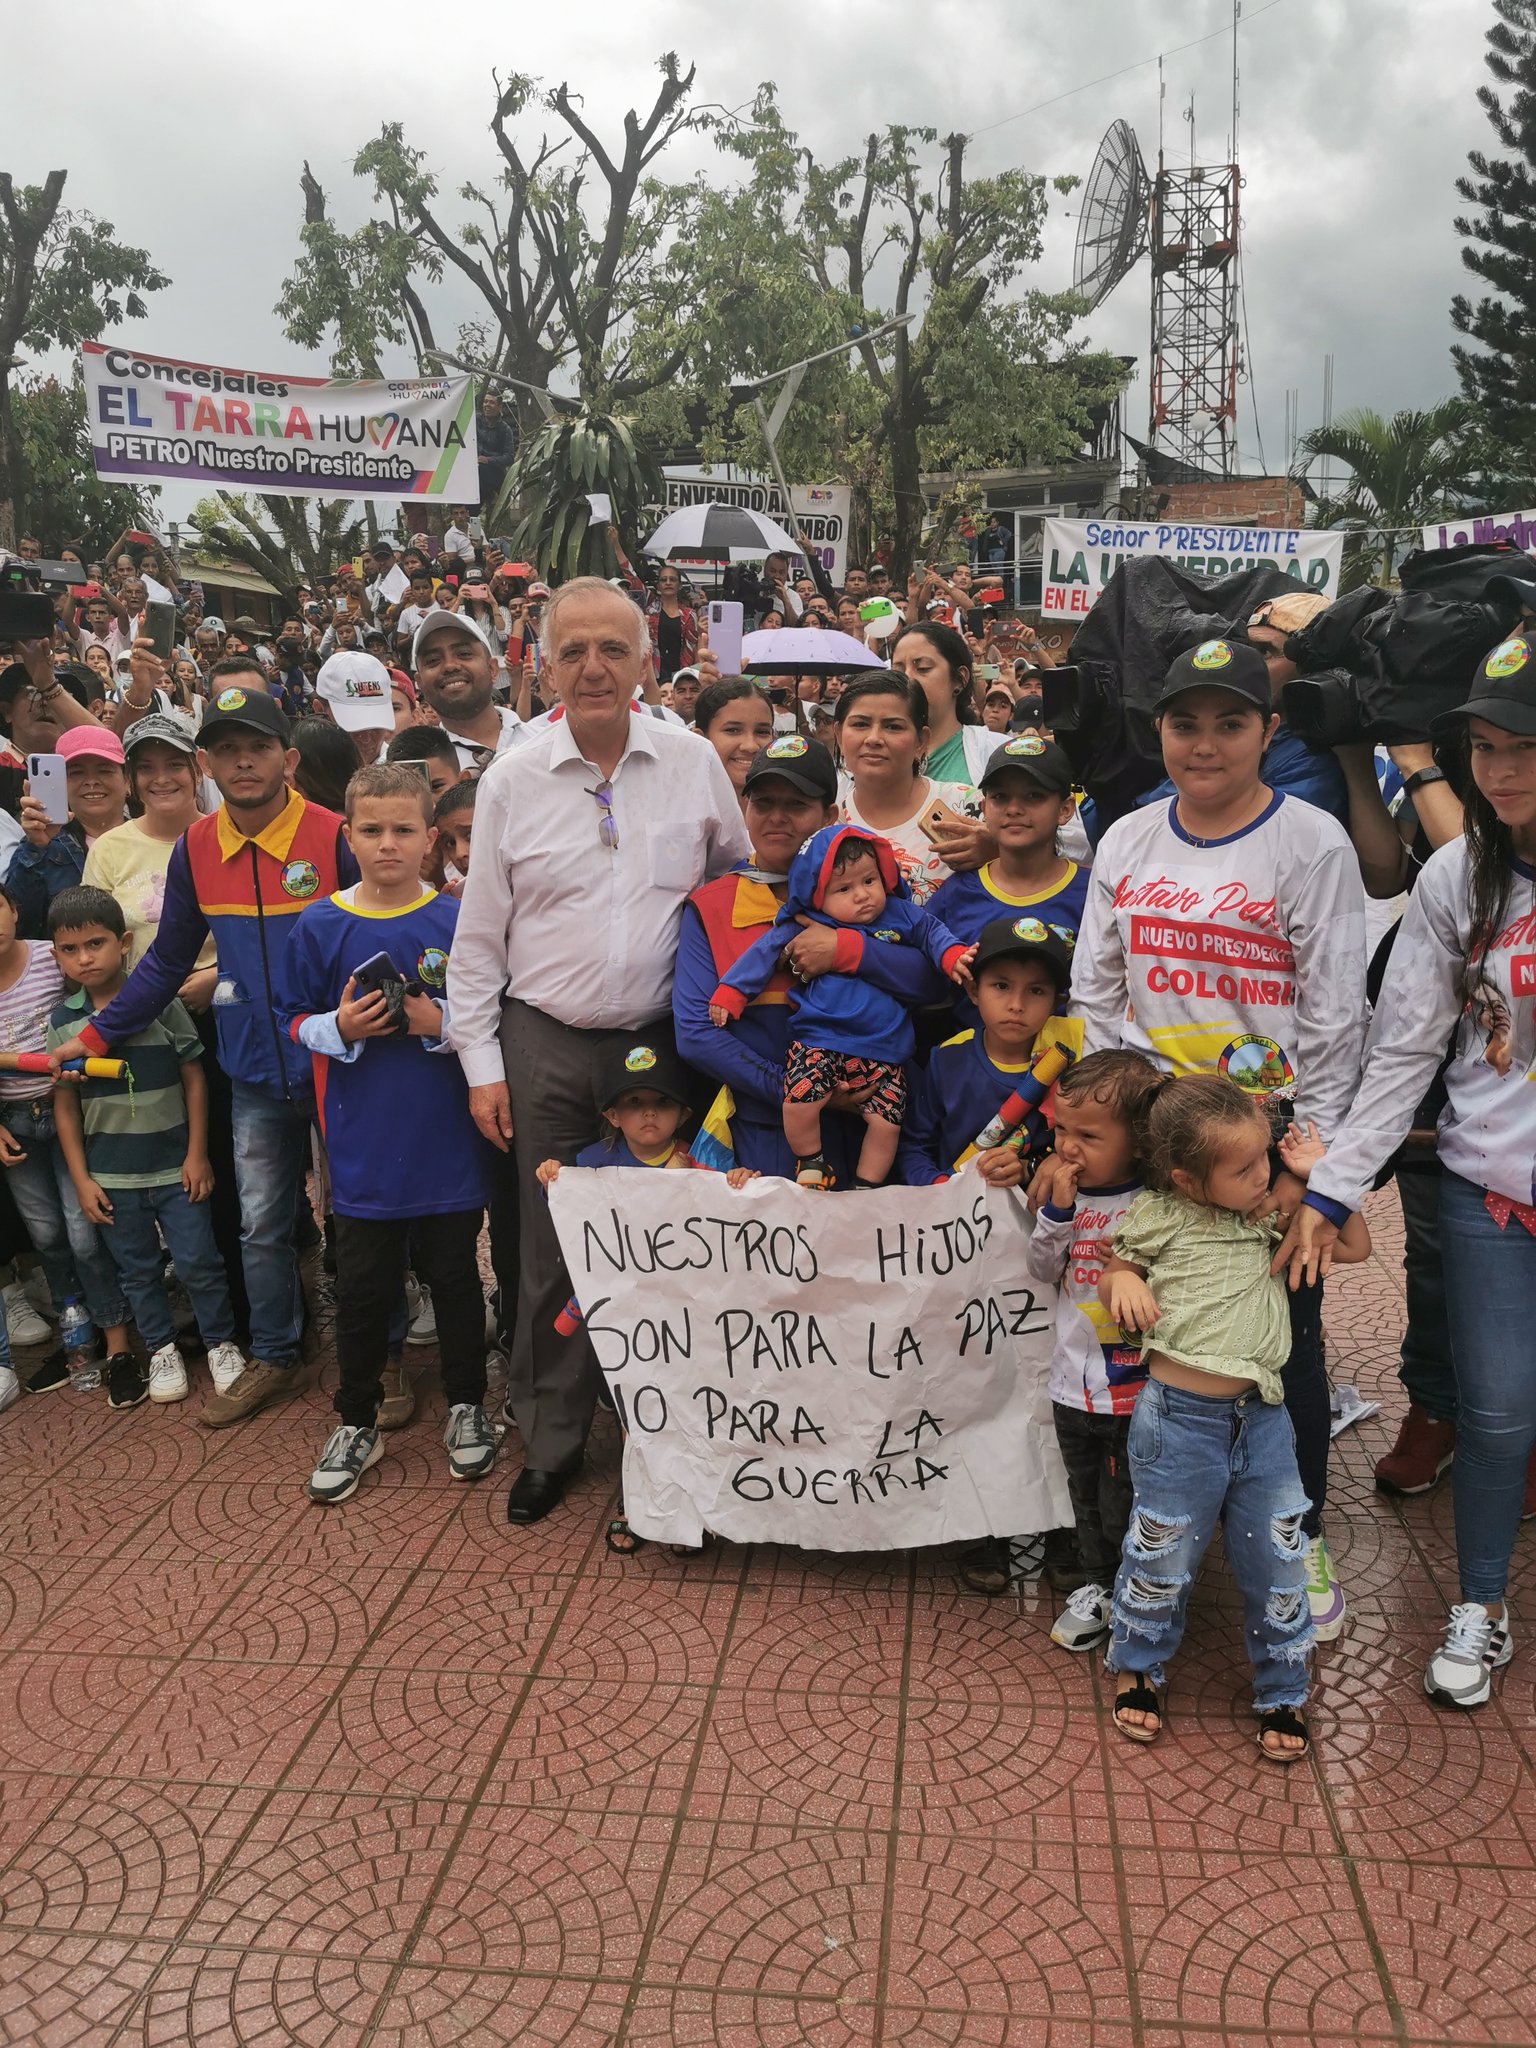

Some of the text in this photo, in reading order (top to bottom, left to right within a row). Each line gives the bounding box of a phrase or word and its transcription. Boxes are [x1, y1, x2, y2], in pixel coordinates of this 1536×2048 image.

[105, 349, 288, 398] Concejales
[388, 381, 450, 391] COLOMBIA
[98, 385, 152, 429] EL
[165, 391, 313, 441] TARRA
[109, 437, 413, 480] PETRO Nuestro Presidente
[652, 483, 764, 512] ENVENIDO
[1086, 523, 1300, 554] Señor PRESIDENTE
[1473, 513, 1536, 550] Madr
[1049, 549, 1090, 585] LA
[1044, 587, 1091, 612] EN EL
[1139, 925, 1197, 951] NUEVO
[1147, 966, 1295, 1006] COLOMBI
[585, 1208, 819, 1282] NUESTROS
[1074, 1245, 1099, 1256] NUEV
[585, 1288, 1049, 1379] SON PARA LA PAZ
[612, 1384, 945, 1459] O PARA LA
[731, 1456, 950, 1505] GUERRA
